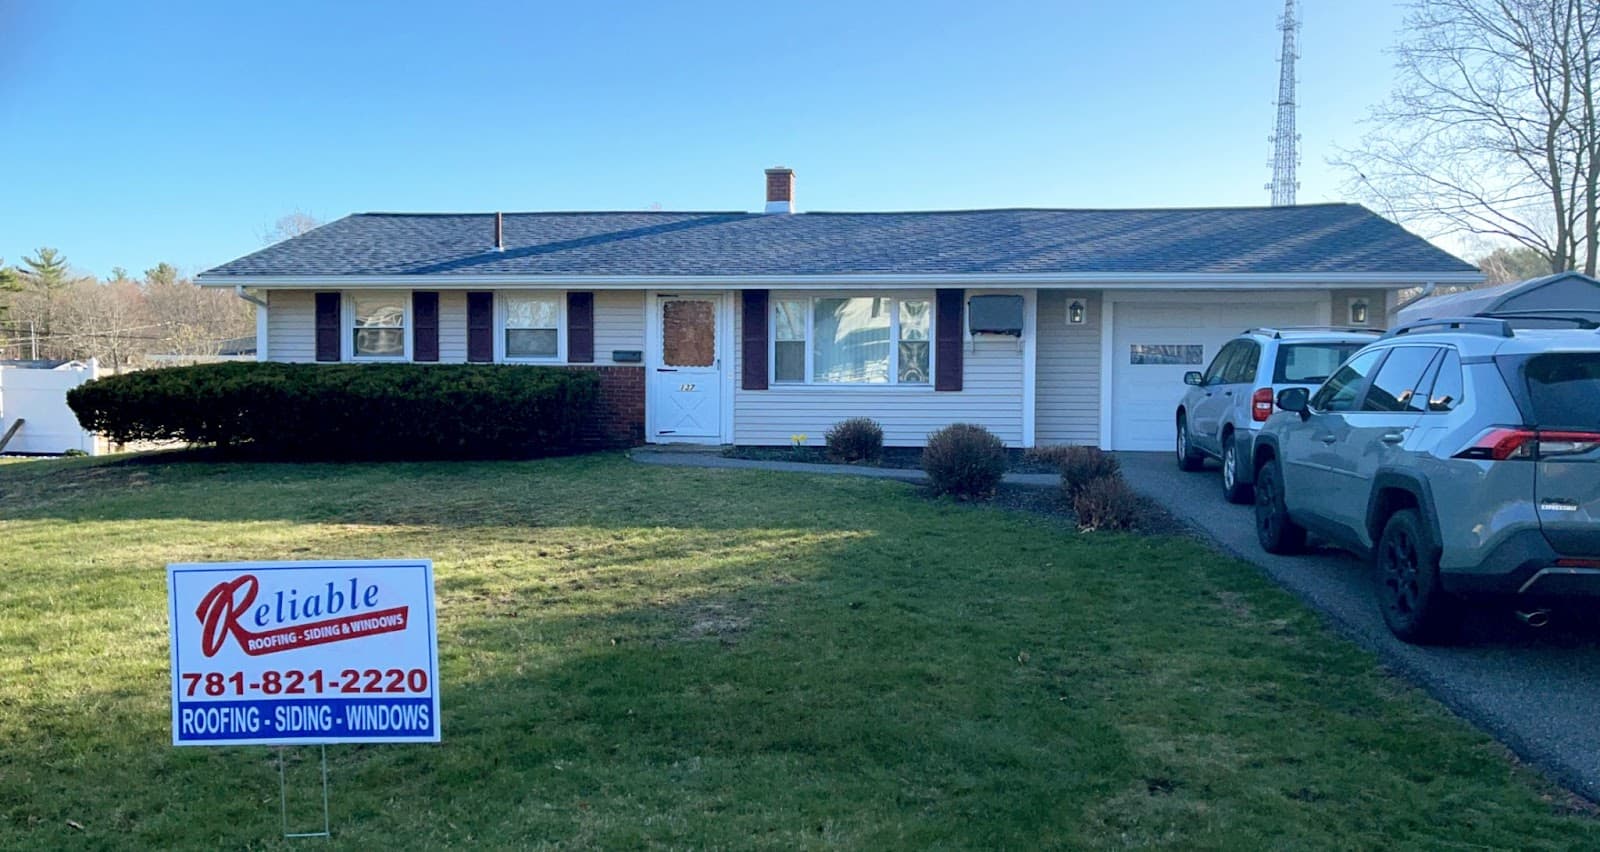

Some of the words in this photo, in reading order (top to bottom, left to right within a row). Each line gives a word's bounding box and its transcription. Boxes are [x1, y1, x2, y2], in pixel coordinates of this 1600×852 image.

[195, 574, 379, 658] Reliable
[248, 632, 297, 651] ROOFING
[303, 624, 340, 641] SIDING
[341, 623, 350, 635] &
[350, 613, 404, 633] WINDOWS
[182, 669, 428, 697] 781-821-2220
[182, 706, 259, 734] ROOFING
[275, 704, 332, 732] SIDING
[345, 704, 430, 731] WINDOWS
